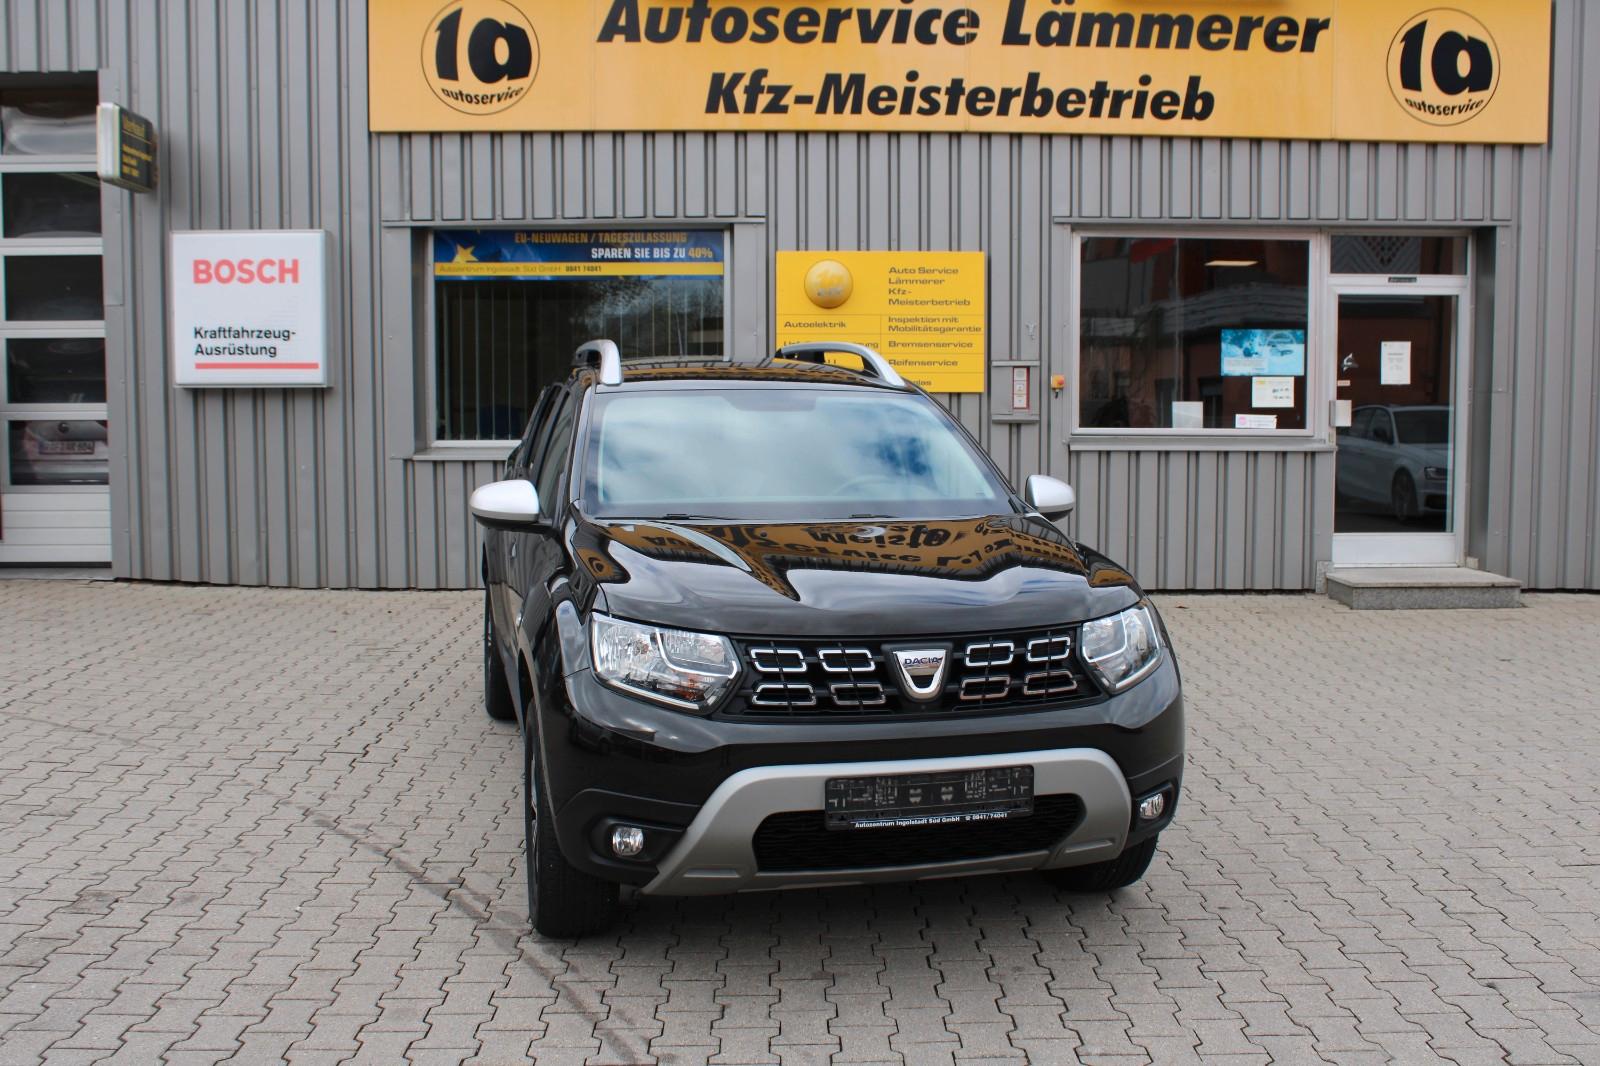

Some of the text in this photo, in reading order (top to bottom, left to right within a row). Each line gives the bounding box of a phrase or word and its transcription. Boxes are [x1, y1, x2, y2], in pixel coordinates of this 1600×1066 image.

[597, 0, 1331, 53] Autoservice Lämmerer
[435, 8, 532, 84] 1a
[1400, 19, 1493, 95] 1a
[441, 86, 524, 105] autoservice
[705, 68, 1214, 121] Kfz-Meisterbetrieb
[1405, 98, 1484, 116] autoservice
[515, 232, 588, 243] EU-NEUWAGEN
[600, 232, 688, 243] TAGESZULASSUNG
[591, 248, 713, 259] SPAREN SIE BIS ZU 40%
[193, 259, 299, 284] BOSCH
[888, 277, 945, 285] Lämmerer
[888, 298, 971, 306] Meisterbetrieb
[888, 316, 941, 324] Inspektion
[194, 327, 296, 341] Kraftfahrzeug-
[888, 325, 981, 333] Mobilitätsgarantie
[195, 343, 277, 357] Ausrüstung
[888, 340, 974, 348] Bremsenservice
[904, 656, 941, 665] DACIA
